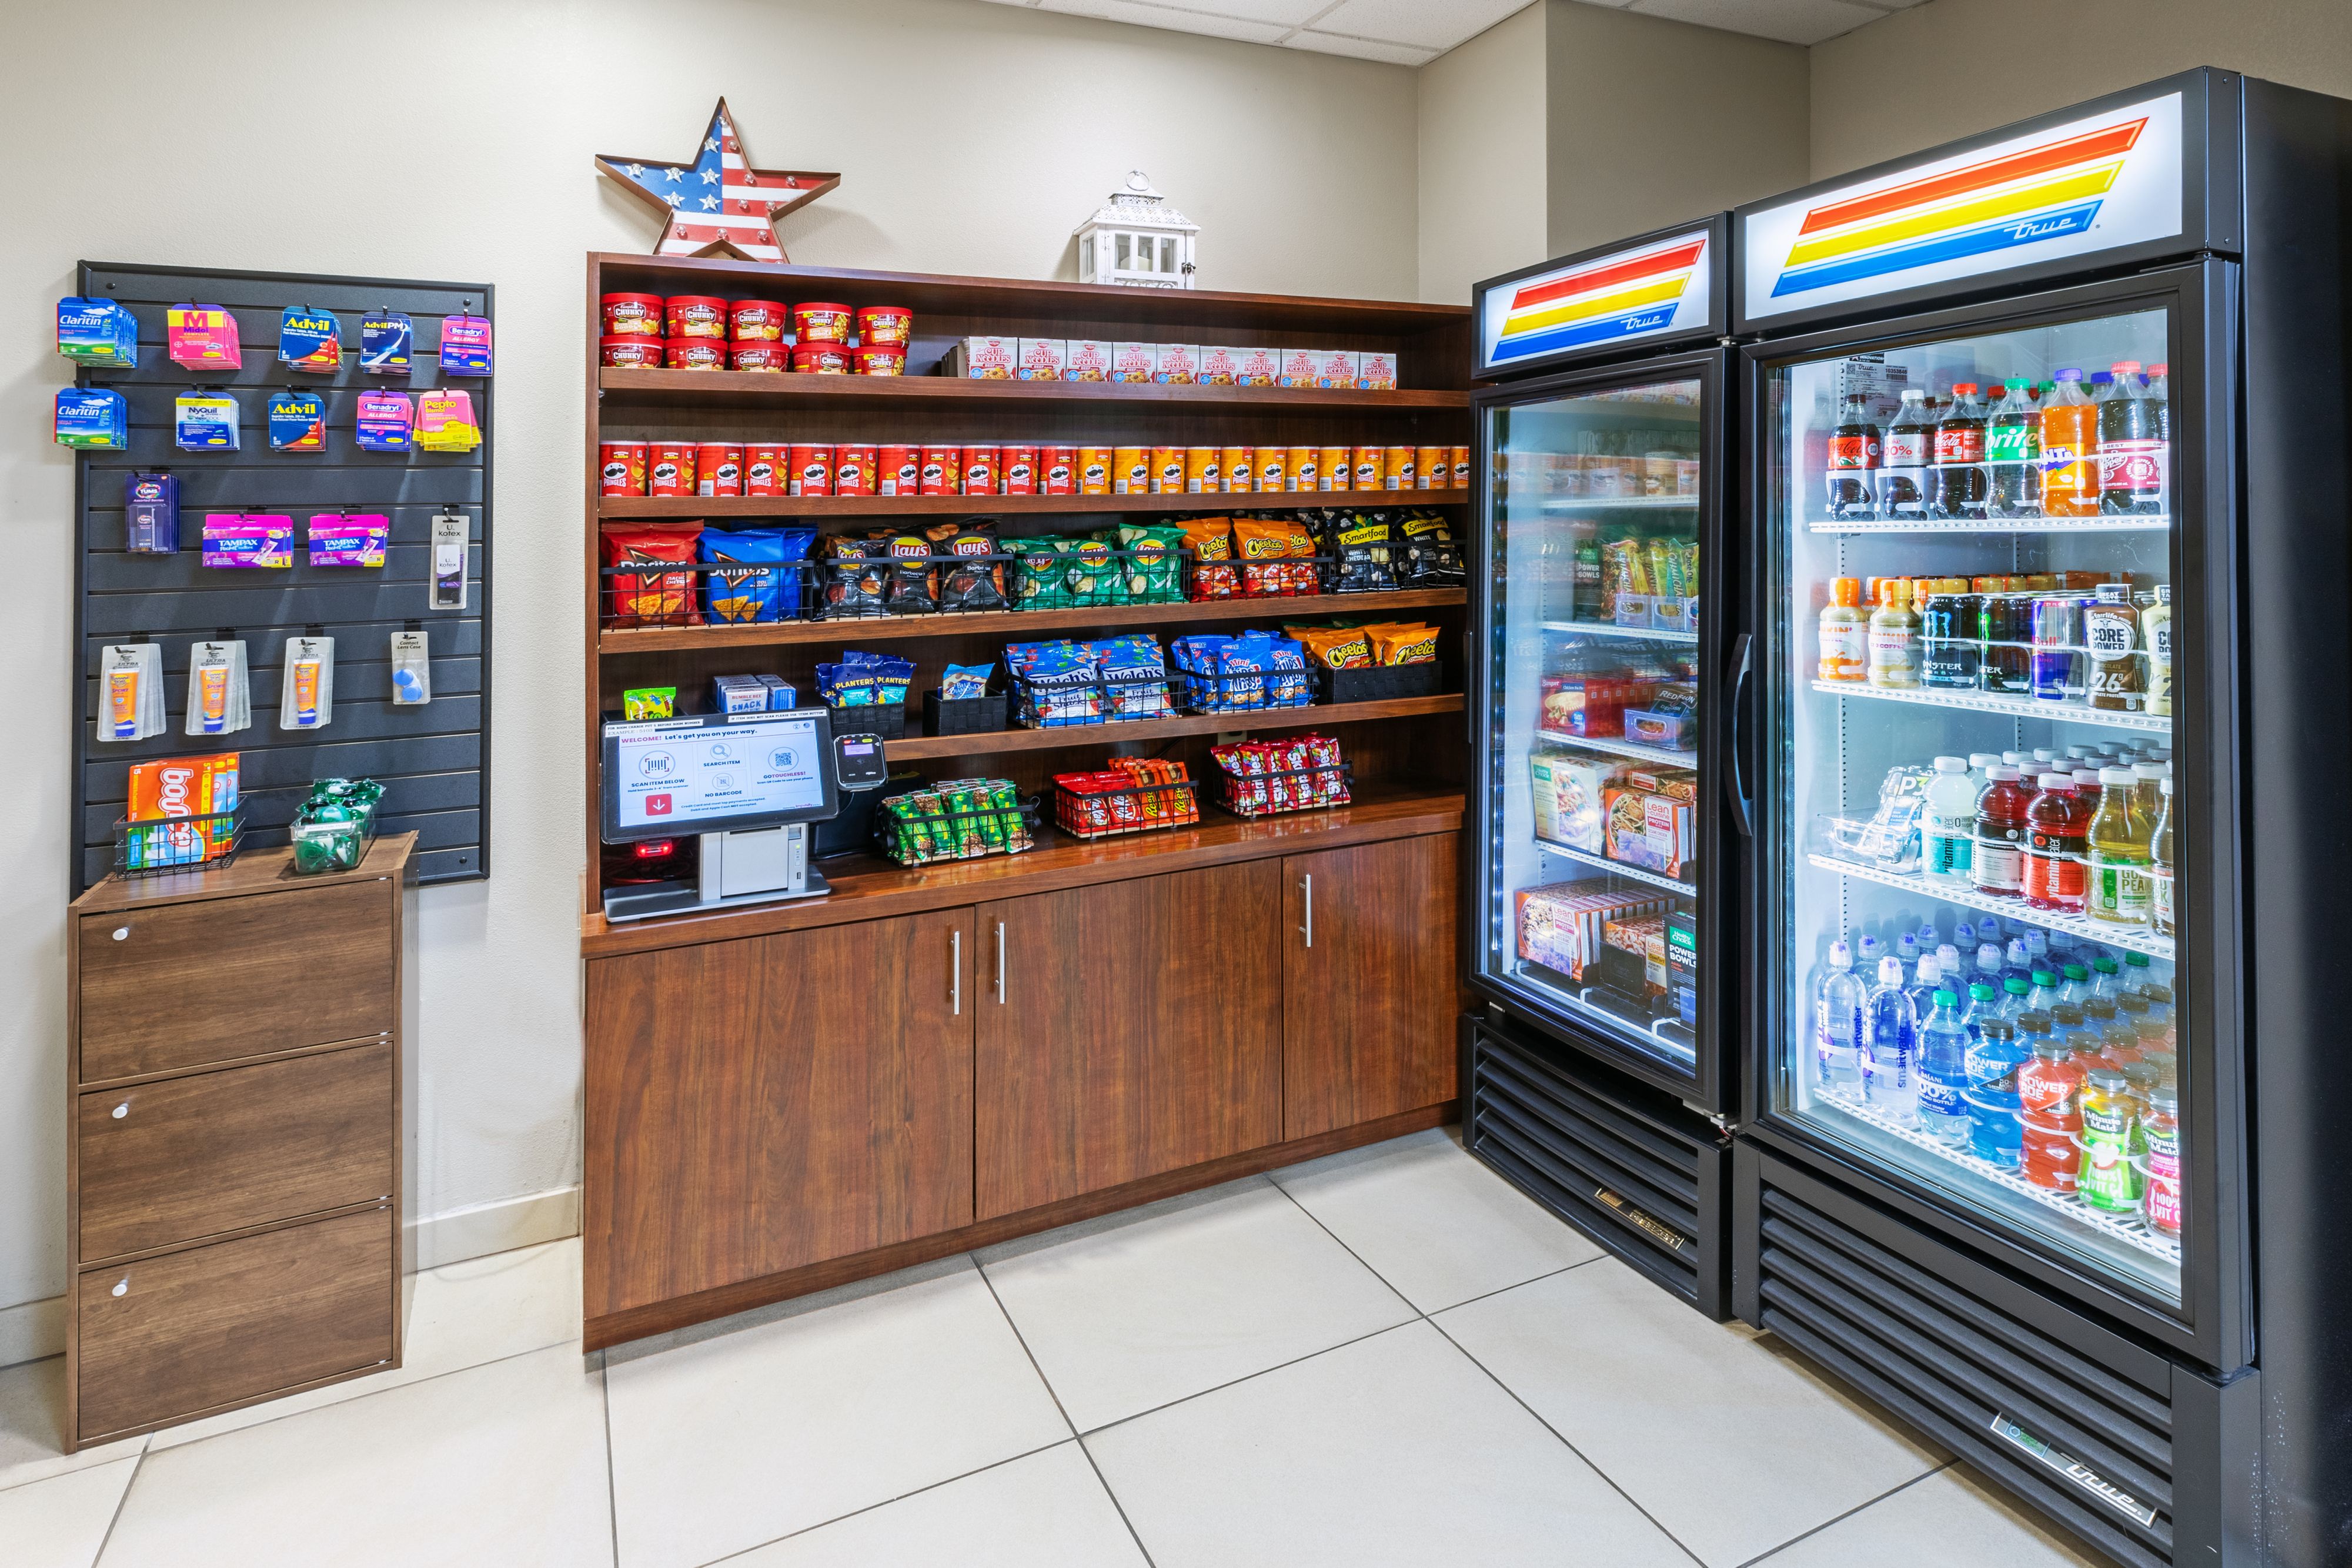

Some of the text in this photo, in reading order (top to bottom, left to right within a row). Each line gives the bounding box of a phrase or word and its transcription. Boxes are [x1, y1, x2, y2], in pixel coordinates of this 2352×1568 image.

[2004, 217, 2079, 239] true
[183, 312, 208, 326] M
[687, 310, 715, 319] CHUNKY
[59, 315, 101, 326] Claritin
[285, 317, 329, 331] Advil
[1620, 315, 1663, 330] true
[452, 327, 484, 336] Benadryl
[822, 357, 843, 365] CHUNKY
[975, 354, 1011, 363] NOODLES
[1025, 356, 1060, 365] NOODLES
[1073, 357, 1105, 366] NOODLES
[1118, 359, 1151, 367] NOODLES
[1287, 365, 1316, 373] NOODLES
[272, 403, 315, 414] Advil
[425, 400, 456, 409] Pepto
[58, 406, 99, 417] Claritin
[603, 479, 626, 488] PRINGLES
[654, 479, 676, 488] PRINGLES
[717, 479, 738, 488] PRINGLES
[750, 479, 770, 488] PRINGLES
[838, 479, 859, 487] PRINGLES
[1085, 477, 1104, 486] PRINGLES
[1408, 520, 1445, 532] Smartfood
[1344, 529, 1387, 544] Smartfood
[895, 542, 927, 557] Lay's
[958, 540, 988, 556] Lay's
[1248, 539, 1282, 555] Cheetos
[2093, 628, 2124, 643] CORE
[2035, 637, 2056, 646] Bull
[1272, 650, 1292, 659] Mini
[1329, 643, 1368, 667] Cheetos
[1230, 658, 1250, 667] Mini
[1108, 667, 1164, 677] Welch's
[836, 678, 874, 690] PLANTERS
[877, 676, 911, 686] PLANTERS
[2096, 672, 2119, 692] 26
[1659, 690, 1678, 700] RED
[731, 701, 761, 711] SNACK
[1647, 801, 1669, 814] Lean
[1648, 818, 1670, 827] PROTEIN
[1672, 935, 1691, 946] Choice
[1673, 930, 1690, 941] Healthy
[1920, 1071, 1943, 1084] DASANI
[2086, 1110, 2121, 1125] Minute
[2090, 1118, 2117, 1132] Maid
